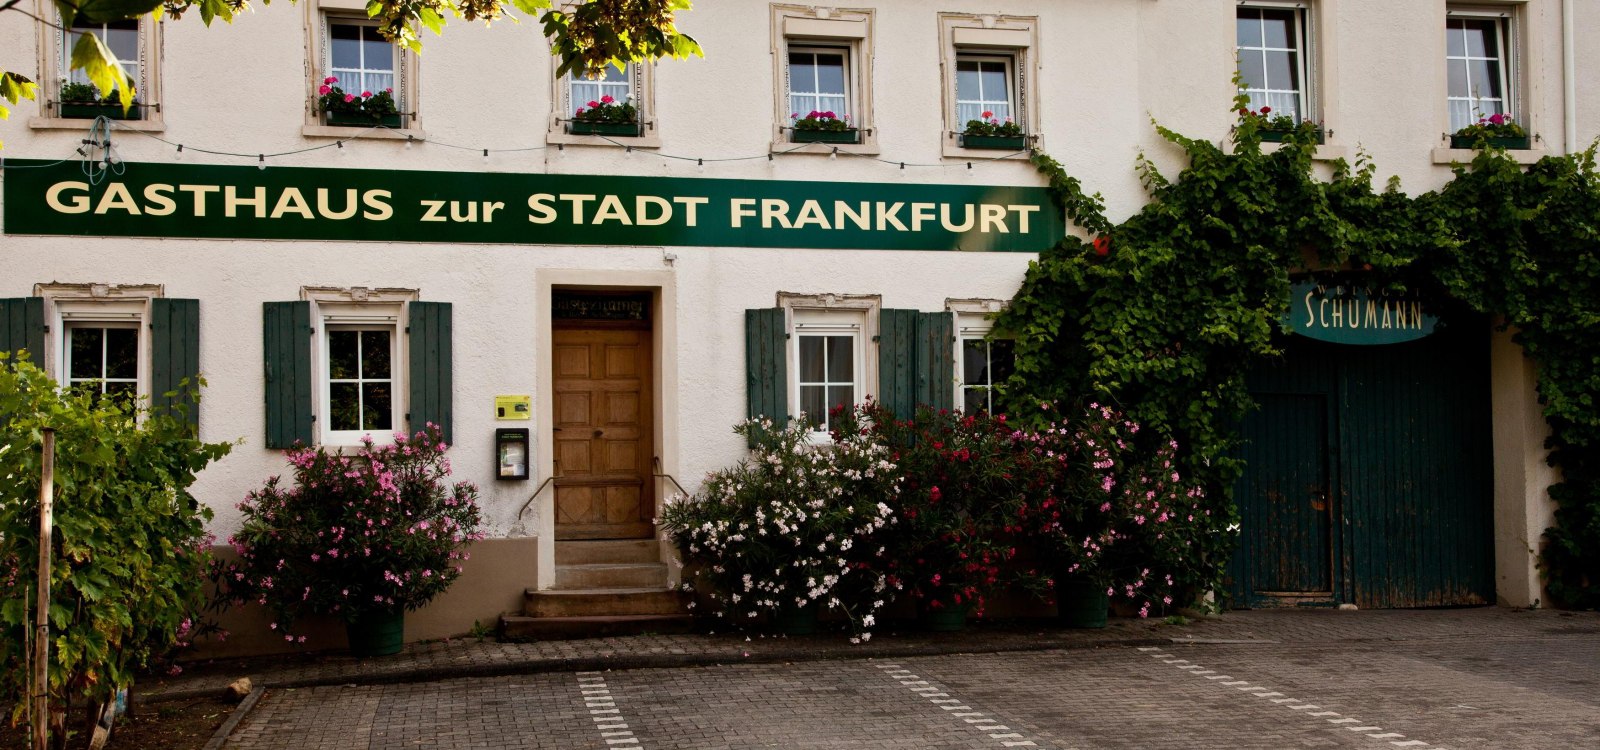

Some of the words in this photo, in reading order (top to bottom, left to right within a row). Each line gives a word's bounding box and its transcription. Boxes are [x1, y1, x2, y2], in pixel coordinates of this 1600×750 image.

[45, 180, 393, 221] GASTHAUS
[420, 200, 505, 223] zur
[527, 193, 709, 227] STADT
[730, 198, 1040, 234] FRANKFURT
[1305, 290, 1422, 330] SCHUMANN
